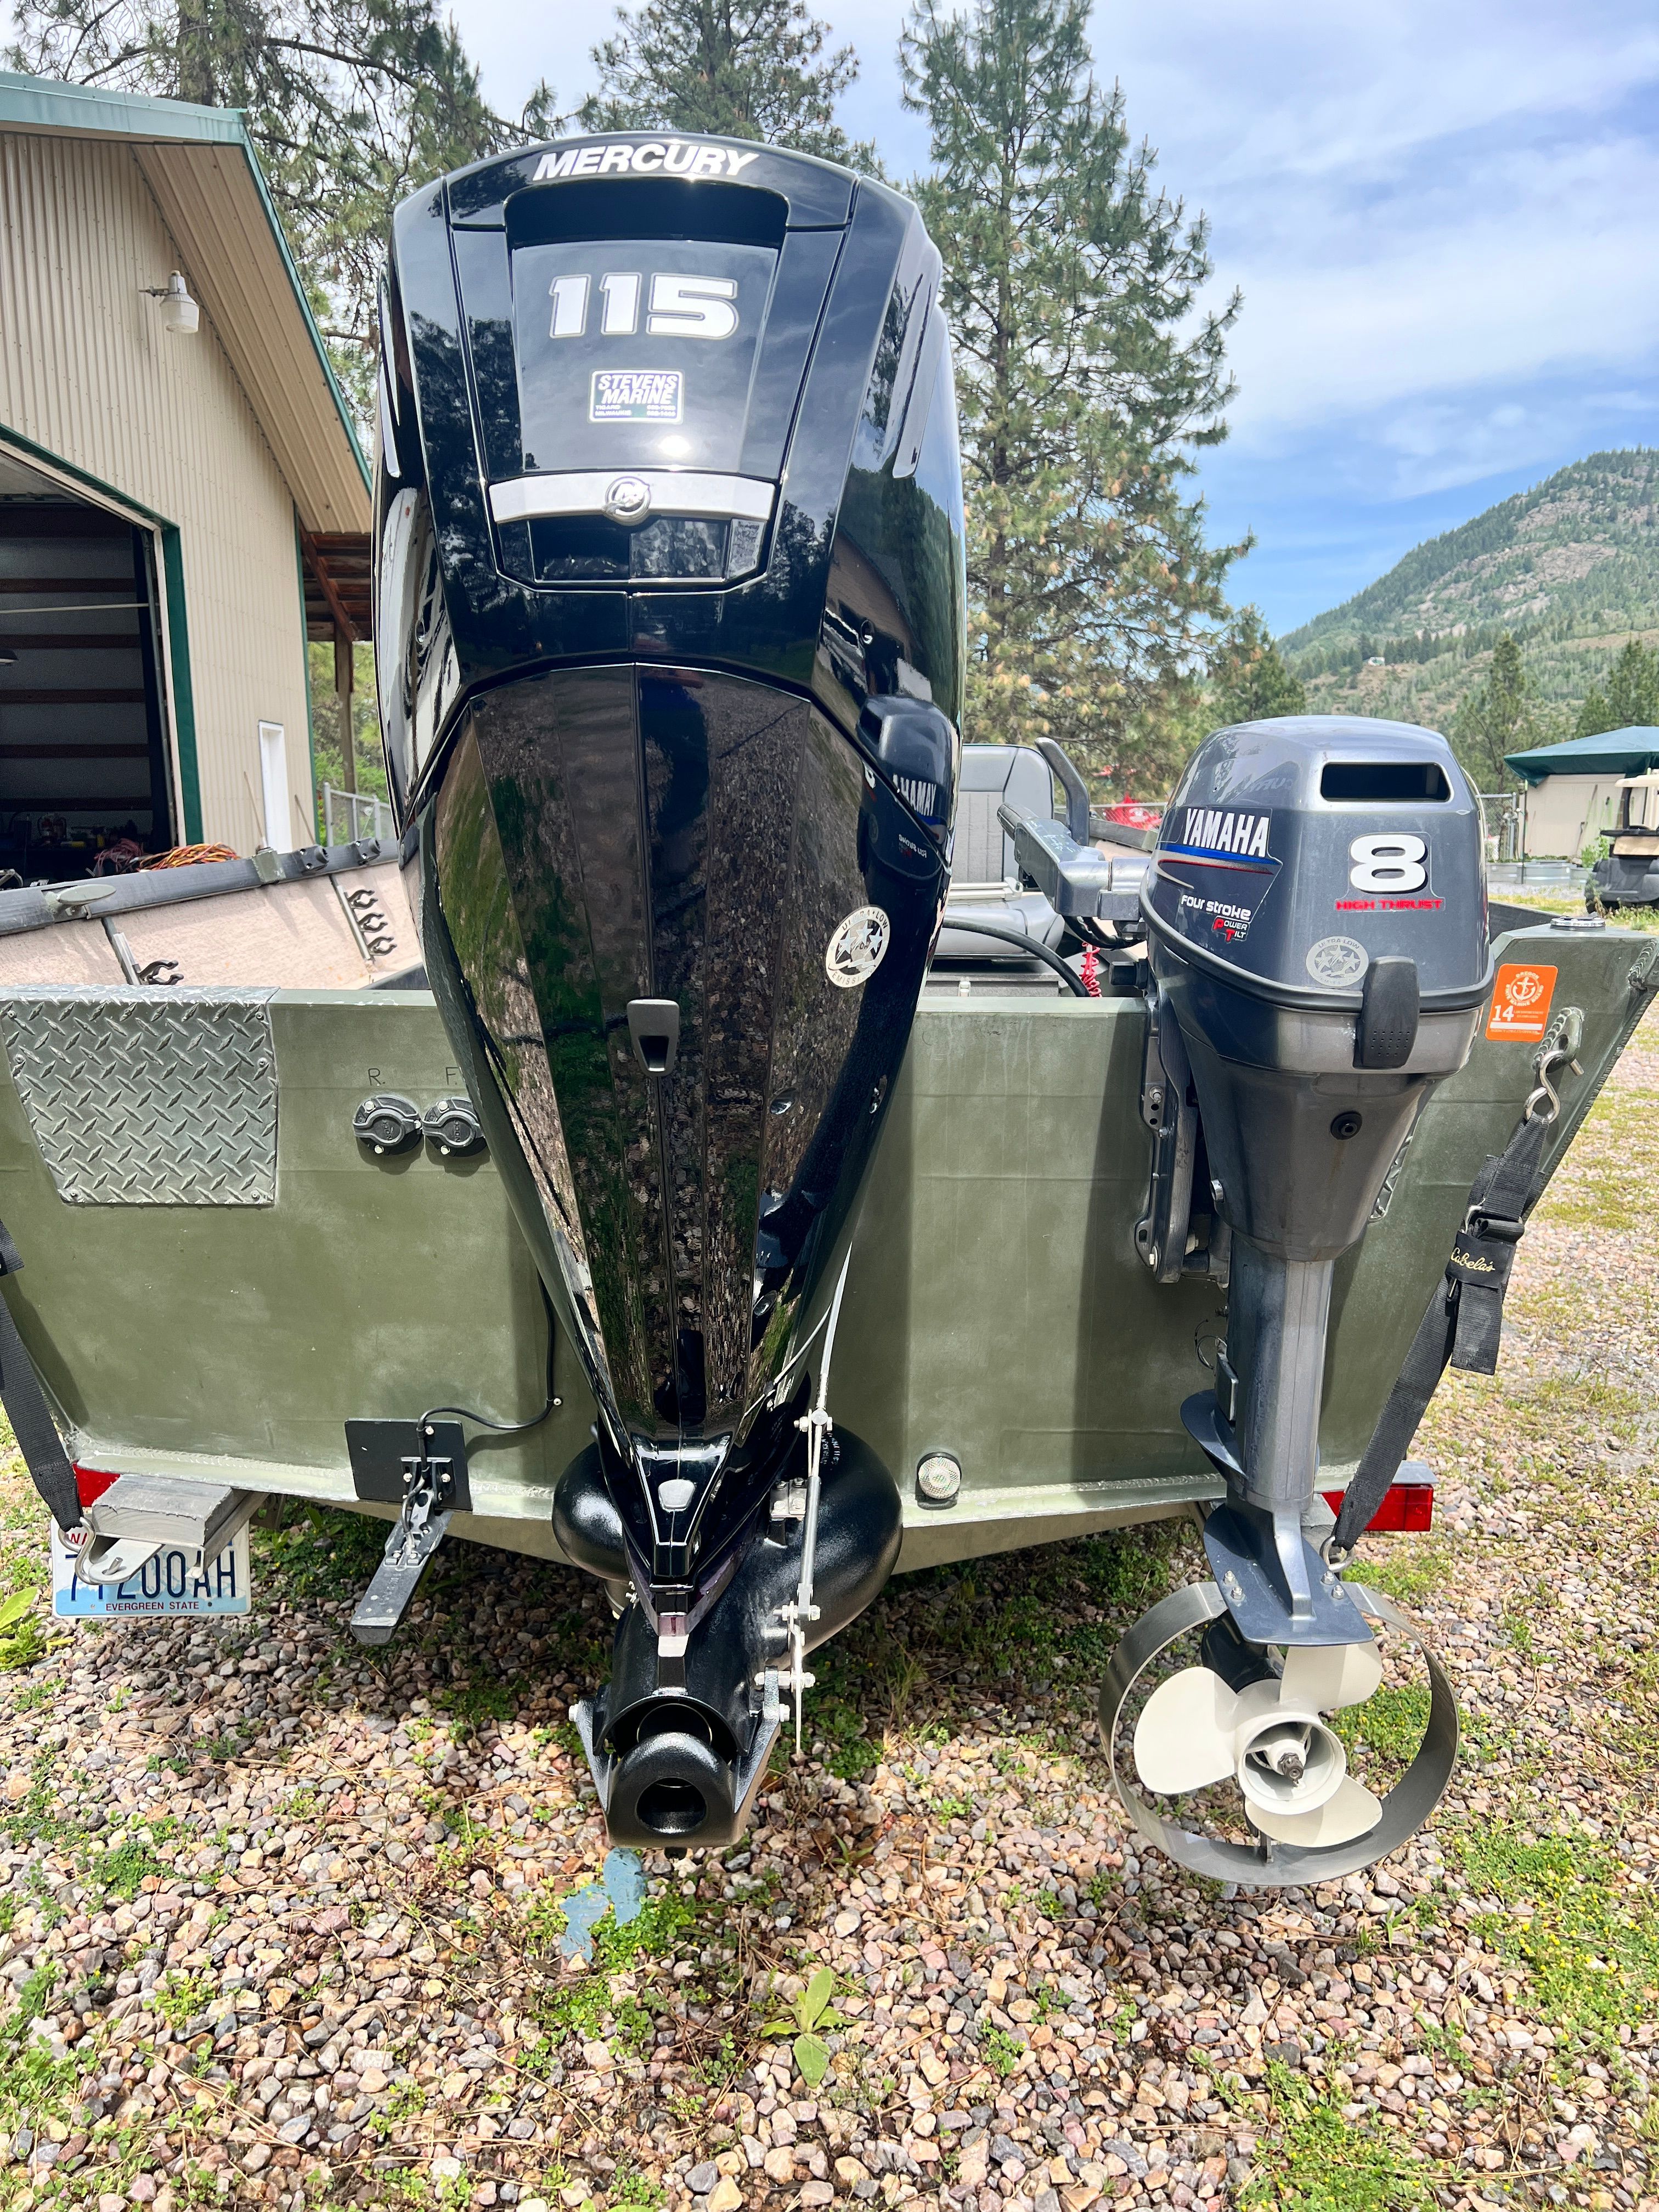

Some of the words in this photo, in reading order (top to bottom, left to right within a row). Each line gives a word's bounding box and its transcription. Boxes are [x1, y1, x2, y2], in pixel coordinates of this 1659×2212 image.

[532, 144, 759, 182] MERCURY
[549, 272, 739, 339] 115
[598, 375, 678, 390] STEVENS
[602, 388, 674, 404] MARINE
[1183, 808, 1269, 857] YAMAHA
[1350, 834, 1428, 894] 8
[1336, 899, 1375, 912] HIGH
[1379, 898, 1443, 910] THRUST
[876, 911, 888, 929] LOW
[1213, 918, 1248, 930] POWER
[1226, 928, 1246, 942] TILT
[1344, 939, 1360, 949] LOW
[1515, 970, 1539, 979] OREGON
[1492, 1005, 1514, 1022] 14
[106, 1602, 164, 1611] EVERGREEN
[169, 1601, 199, 1610] STATE
